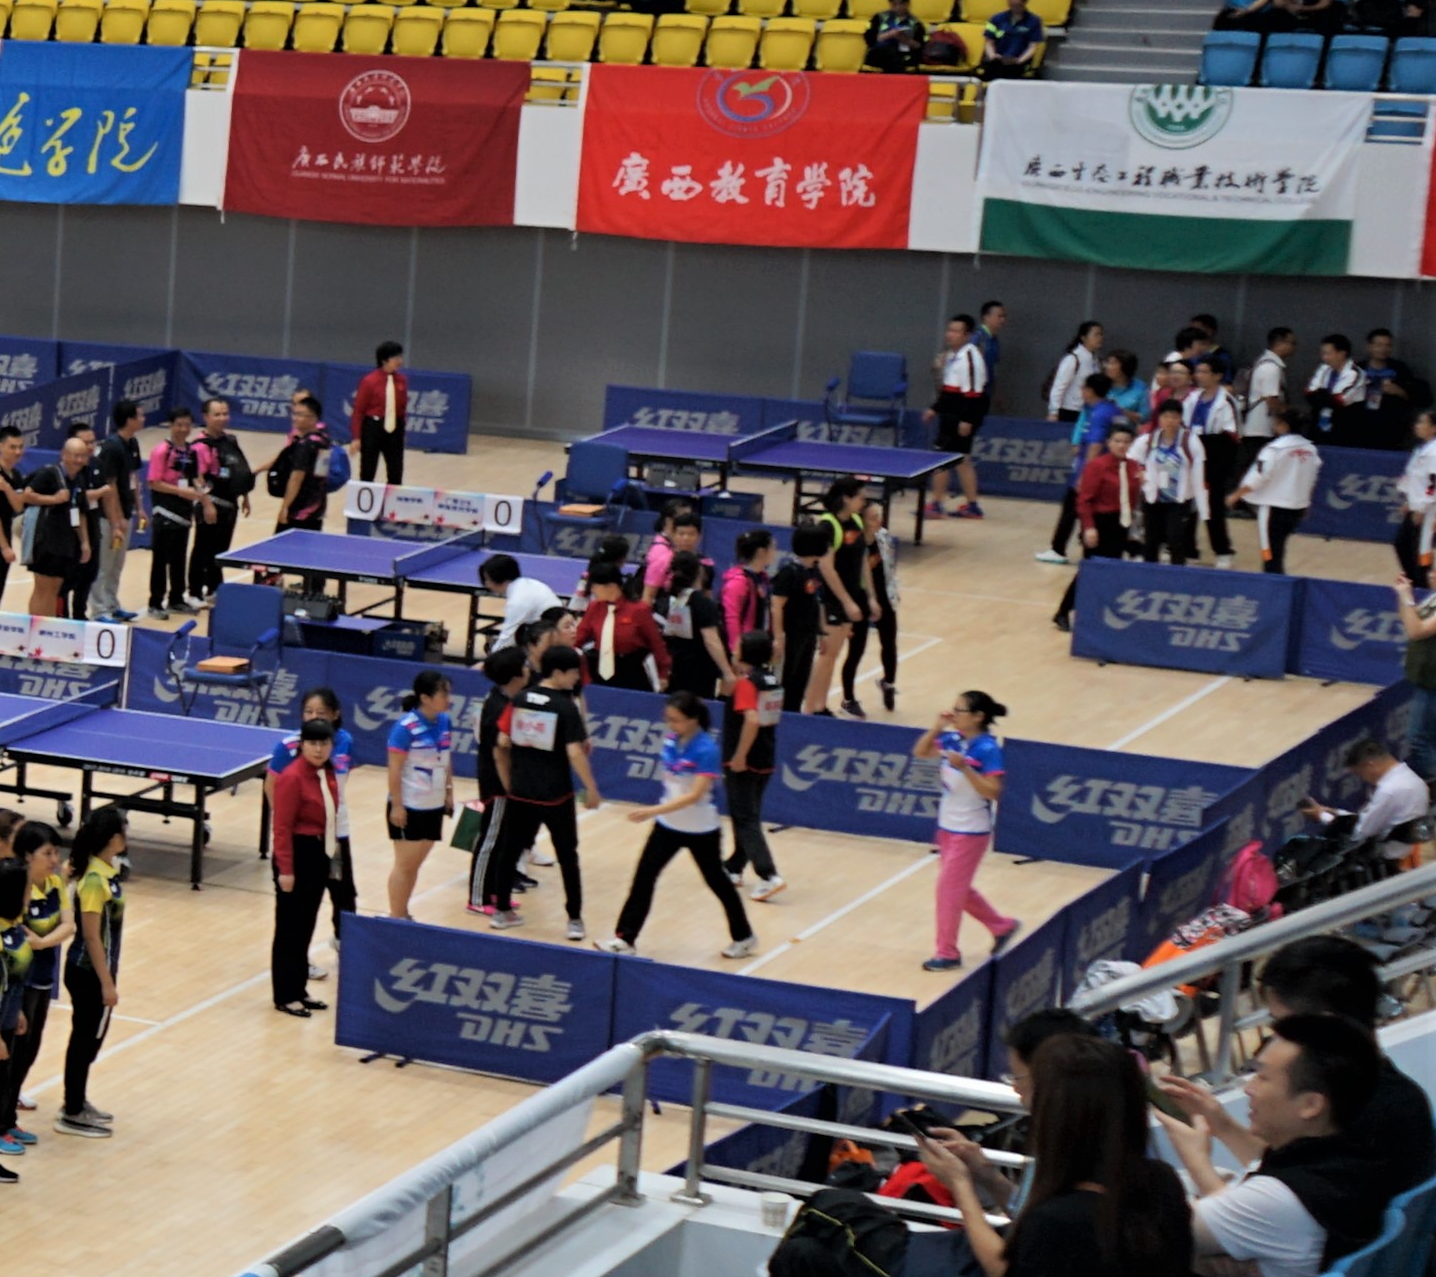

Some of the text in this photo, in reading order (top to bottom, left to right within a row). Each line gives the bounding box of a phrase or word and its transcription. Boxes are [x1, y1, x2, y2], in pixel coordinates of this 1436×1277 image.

[1103, 586, 1259, 633] 红双喜
[782, 743, 940, 793] 红双喜
[1033, 772, 1212, 827] 红双喜
[374, 957, 572, 1022] 红双喜
